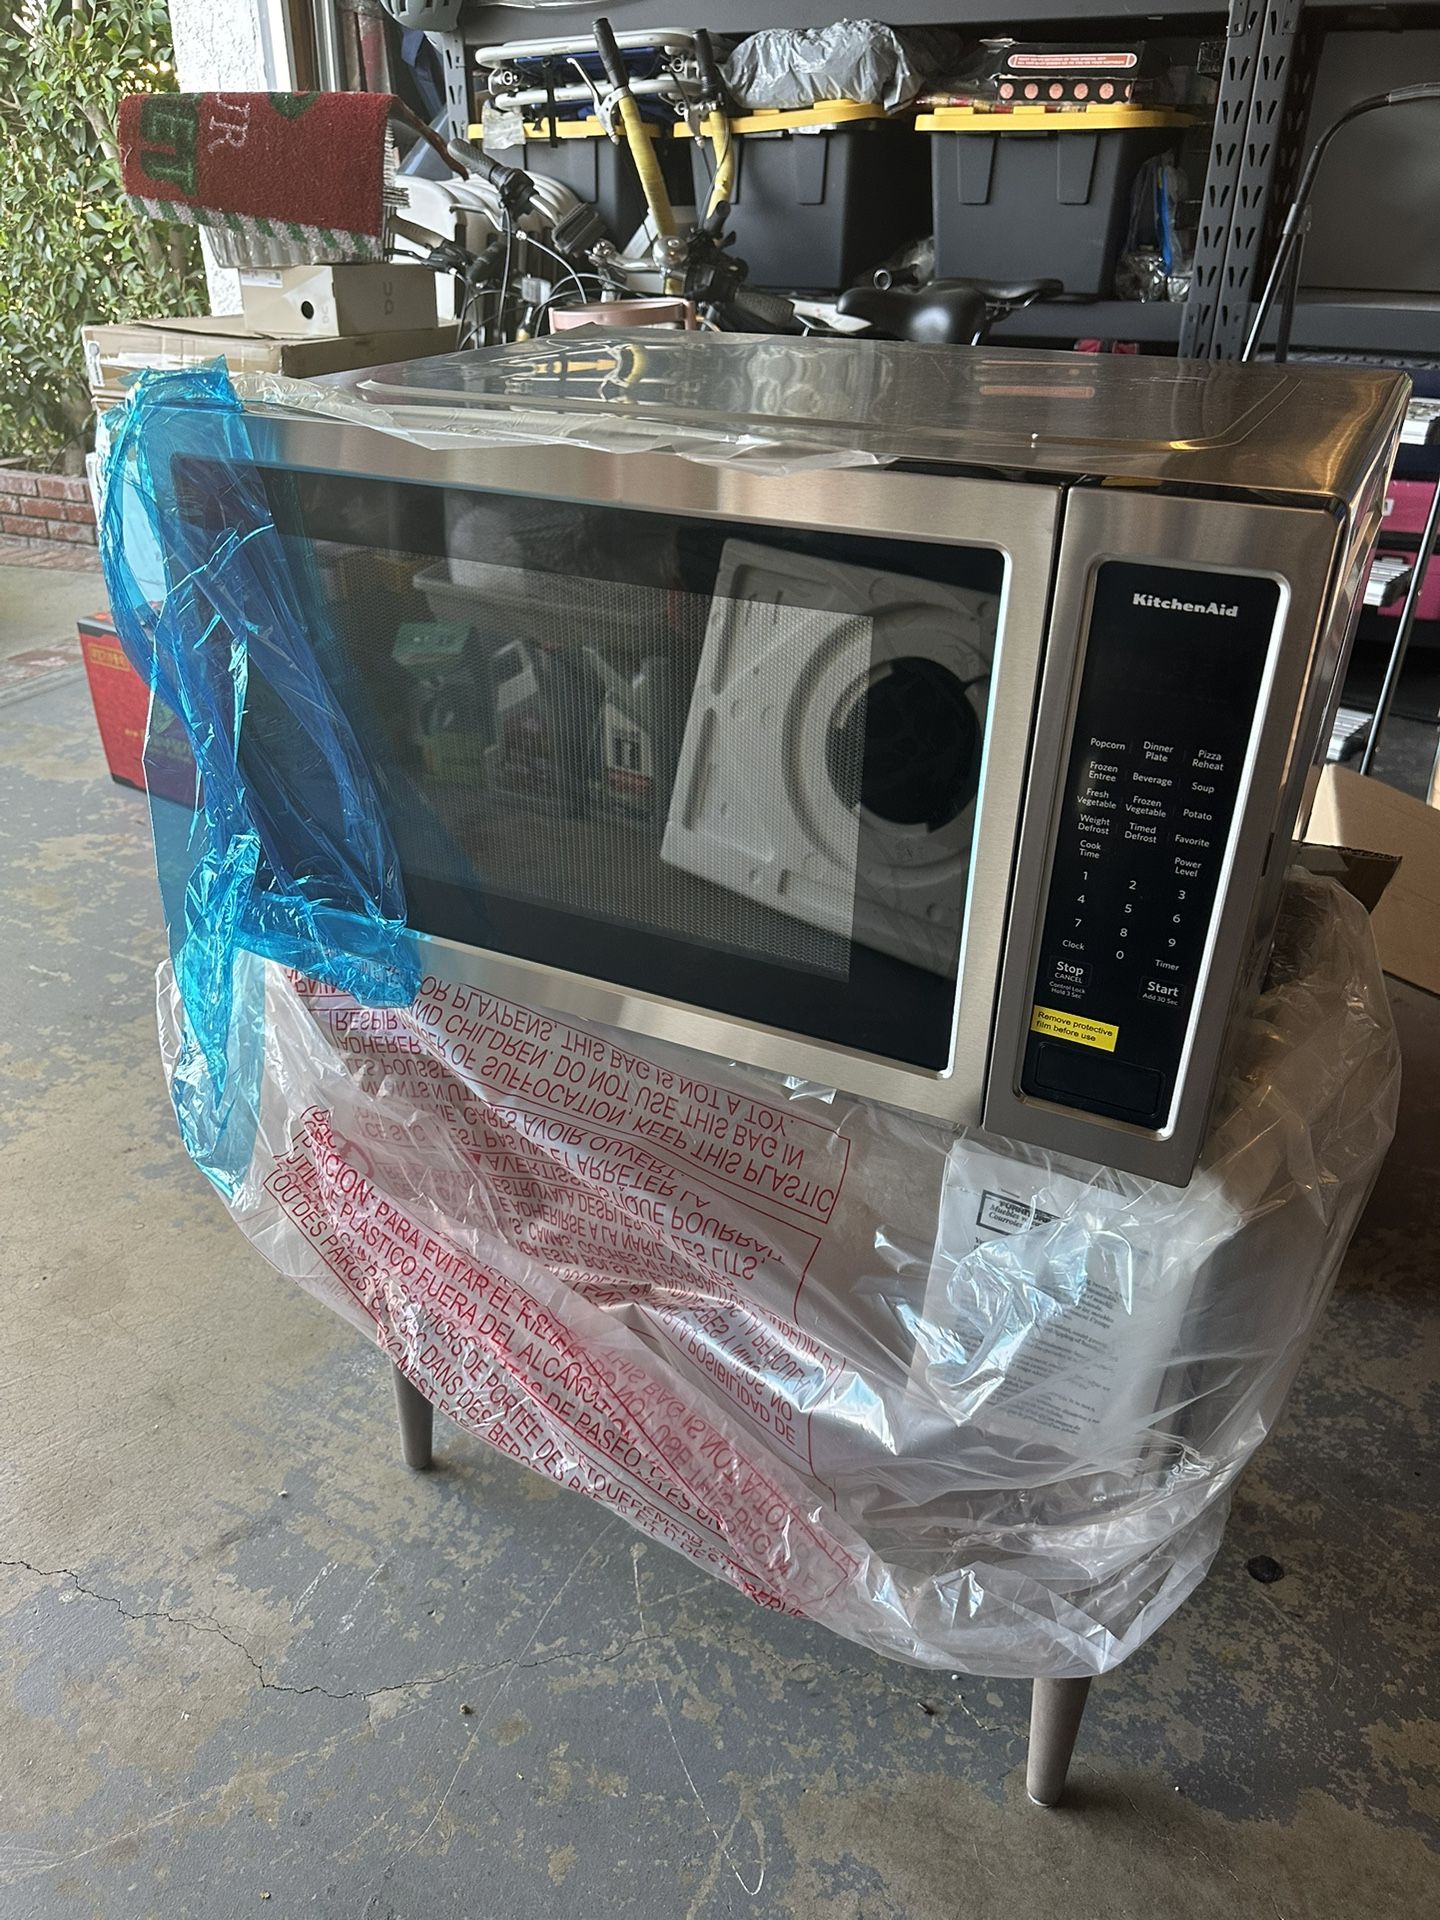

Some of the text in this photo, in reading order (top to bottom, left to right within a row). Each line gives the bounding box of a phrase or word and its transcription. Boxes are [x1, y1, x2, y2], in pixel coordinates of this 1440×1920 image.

[1133, 593, 1239, 618] KitchenAid
[1090, 738, 1125, 751] Popcorn
[1144, 741, 1173, 754] Dinner
[1146, 752, 1168, 763] Plate
[1198, 750, 1222, 761] Pizza
[1090, 761, 1118, 773] Frozen
[1192, 759, 1224, 772] Reheat
[1089, 771, 1116, 782] Entree
[1133, 773, 1172, 787] Beverage
[1086, 788, 1109, 799] Fresh
[1192, 782, 1214, 794] Soup
[1077, 796, 1116, 810] Vegetable
[1133, 796, 1161, 807] Frozen
[1126, 804, 1166, 818] Vegetable
[1183, 809, 1212, 821] Potato
[1080, 814, 1110, 827] Weight
[1078, 823, 1109, 835] Defrost
[1129, 822, 1156, 834] Timed
[1125, 831, 1157, 844] Defrost
[1175, 834, 1210, 848] Favorite
[1080, 840, 1101, 850] Cook
[1079, 848, 1100, 860] Time
[1174, 857, 1201, 869] Power
[1083, 871, 1088, 880] 1
[1175, 867, 1197, 878] Level
[1129, 880, 1136, 890] 2
[1078, 895, 1085, 904] 4
[1179, 890, 1186, 900] 3
[1125, 904, 1132, 913] 5
[1074, 918, 1082, 927] 7
[1173, 913, 1180, 923] 6
[1120, 927, 1128, 937] 8
[1063, 939, 1085, 951] Clock
[1168, 938, 1176, 948] 9
[1116, 950, 1124, 960] 0
[1056, 961, 1084, 976] Stop
[1155, 959, 1179, 971] Timer
[1054, 972, 1082, 984] CANCEL
[1148, 981, 1179, 997] Start
[1143, 993, 1156, 1001] Add
[1157, 995, 1165, 1003] 30
[1038, 1011, 1113, 1038] Remove protective
[1036, 1020, 1096, 1042] film before use
[292, 1201, 327, 1237] DES
[375, 1201, 420, 1250] PARA
[422, 1239, 489, 1298] EVITAR
[488, 1286, 513, 1317] EL
[415, 1267, 478, 1326] FUERA
[478, 1313, 515, 1353] DEL
[420, 1345, 463, 1396] DANS
[463, 1350, 489, 1382] DE
[484, 1373, 544, 1447] PORTÉE
[545, 1392, 575, 1417] DE
[574, 1411, 642, 1467] PASEO
